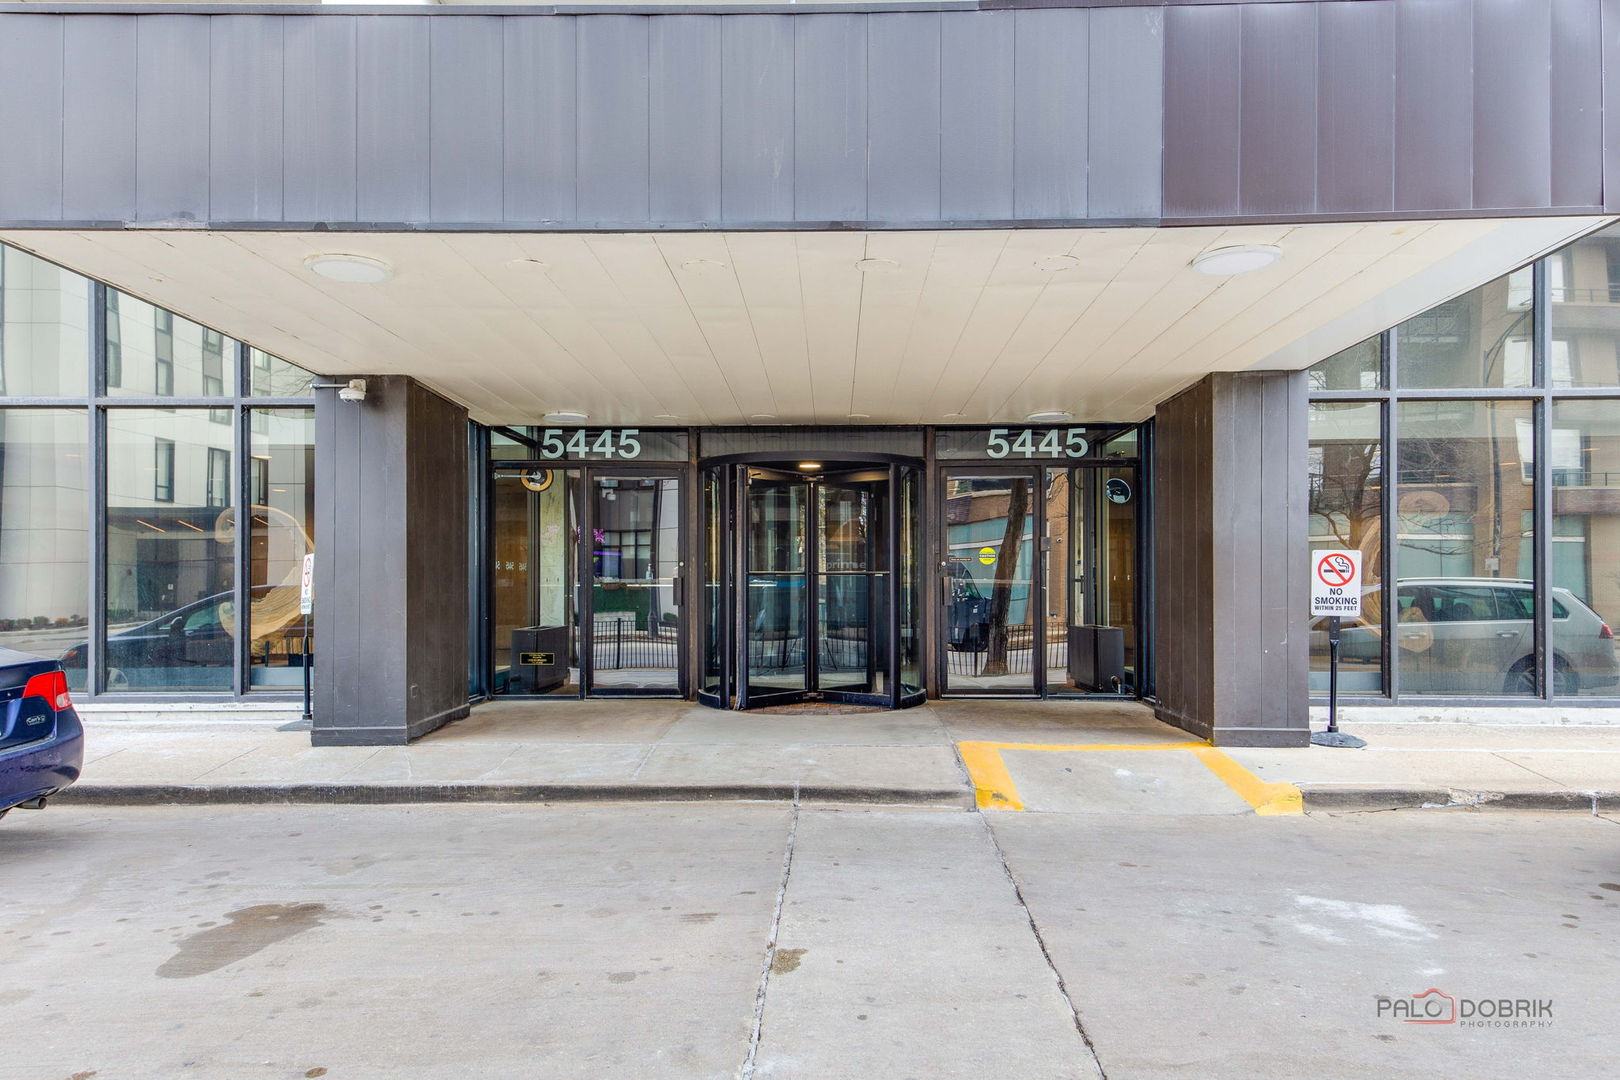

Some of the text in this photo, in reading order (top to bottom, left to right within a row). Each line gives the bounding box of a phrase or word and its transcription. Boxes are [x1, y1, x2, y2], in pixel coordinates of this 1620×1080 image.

[541, 429, 641, 459] 5445
[986, 427, 1089, 459] 5445
[1314, 597, 1358, 605] SMOKING
[1329, 588, 1343, 596] NO
